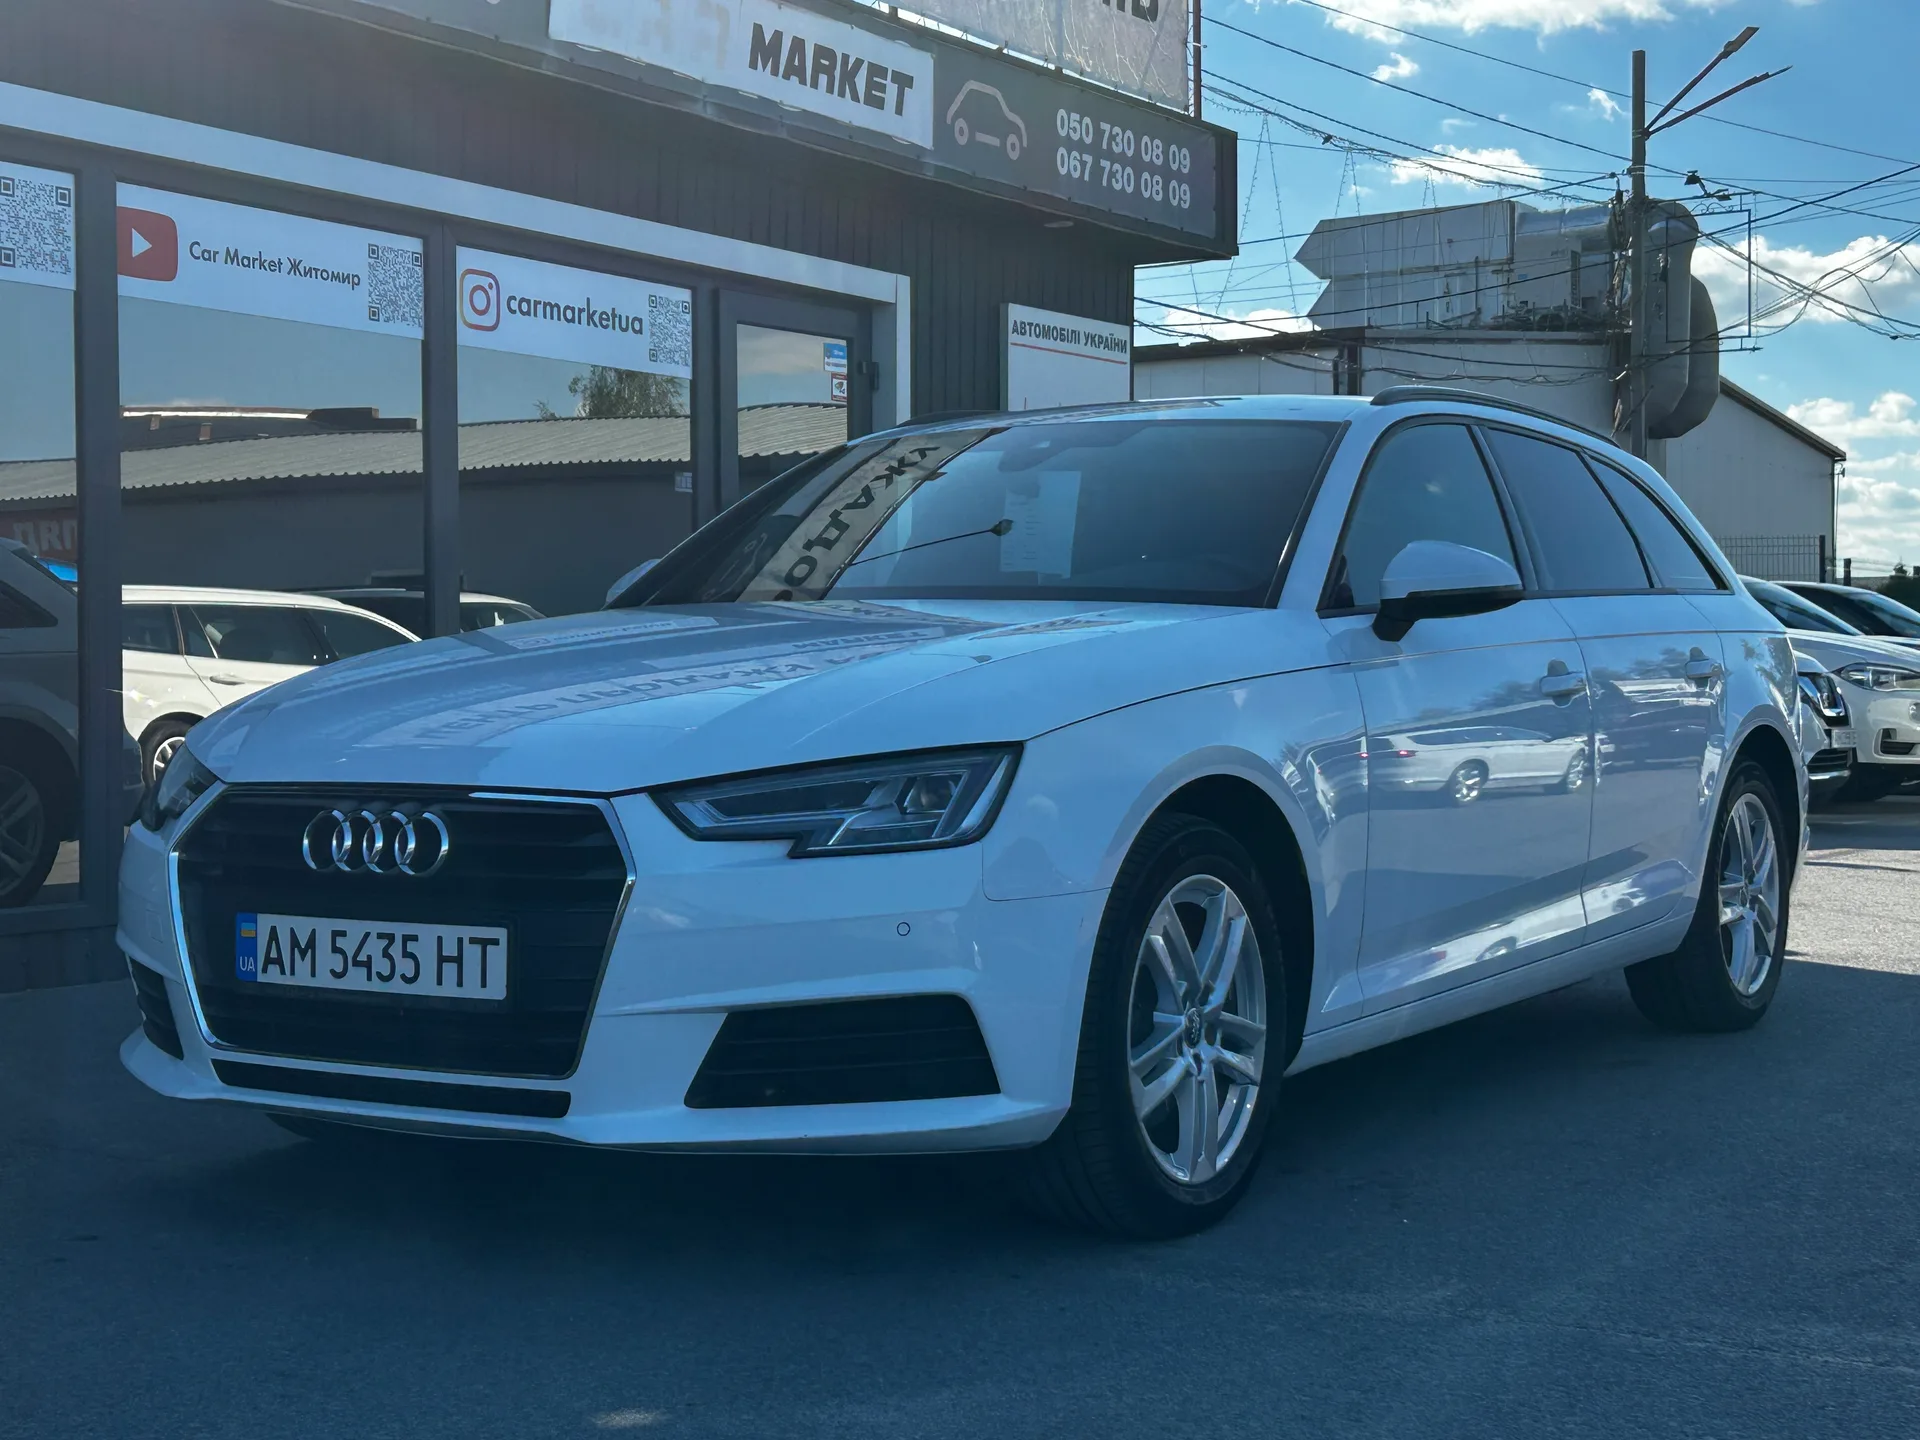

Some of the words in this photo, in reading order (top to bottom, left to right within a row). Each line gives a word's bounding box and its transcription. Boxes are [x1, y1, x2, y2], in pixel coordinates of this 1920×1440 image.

[748, 22, 914, 117] MARKET
[1056, 108, 1093, 144] 050
[1100, 122, 1135, 157] 730
[1141, 135, 1163, 166] 08
[1169, 144, 1191, 174] 09
[1056, 146, 1093, 182] 067
[1100, 159, 1135, 194] 730
[1141, 171, 1163, 201] 08
[1169, 180, 1191, 209] 09
[189, 240, 219, 264] Car
[224, 246, 283, 274] Market
[286, 256, 361, 291] Житомир
[506, 294, 644, 335] carmarketua
[1011, 319, 1081, 345] АВТОМОБІЛІ
[1083, 330, 1128, 354] УКРАЇНИ
[239, 956, 256, 972] UA
[261, 925, 317, 978] AM
[329, 930, 421, 985] 5435
[436, 935, 500, 988] HT
